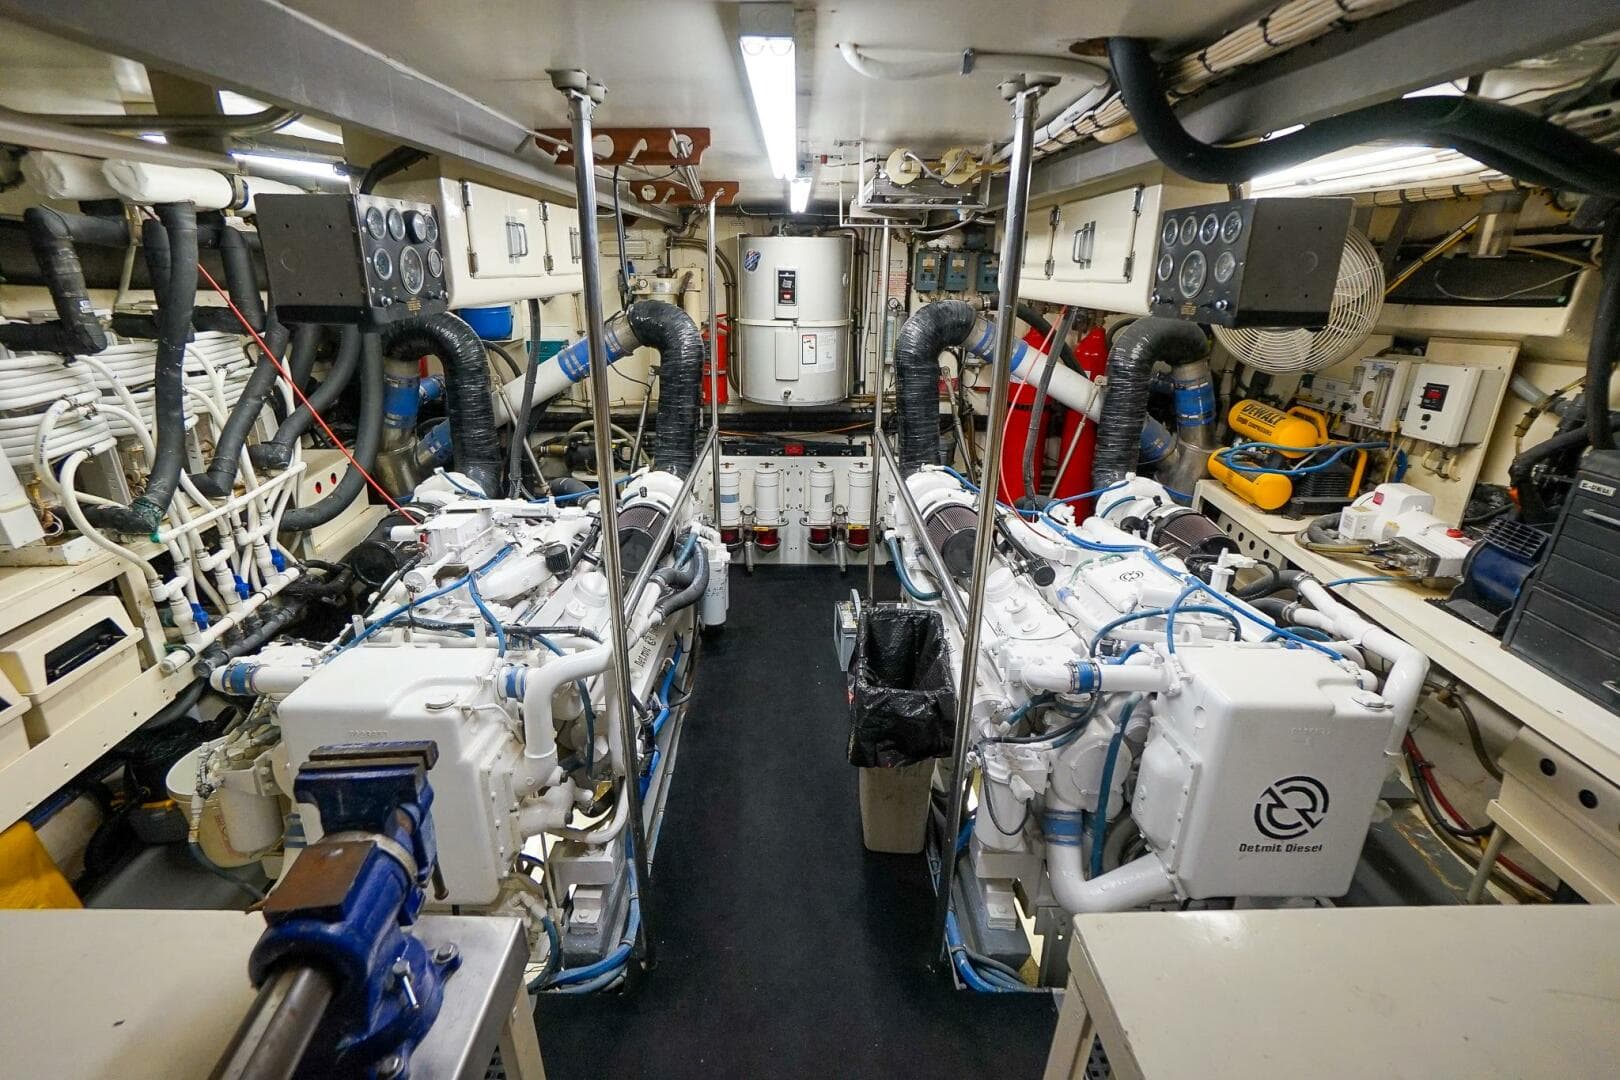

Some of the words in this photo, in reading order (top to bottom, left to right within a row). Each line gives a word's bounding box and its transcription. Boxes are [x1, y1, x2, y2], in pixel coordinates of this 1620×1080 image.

[1241, 403, 1286, 425] DEWALT
[1239, 843, 1282, 853] Detroit
[1285, 843, 1323, 853] Diesel
